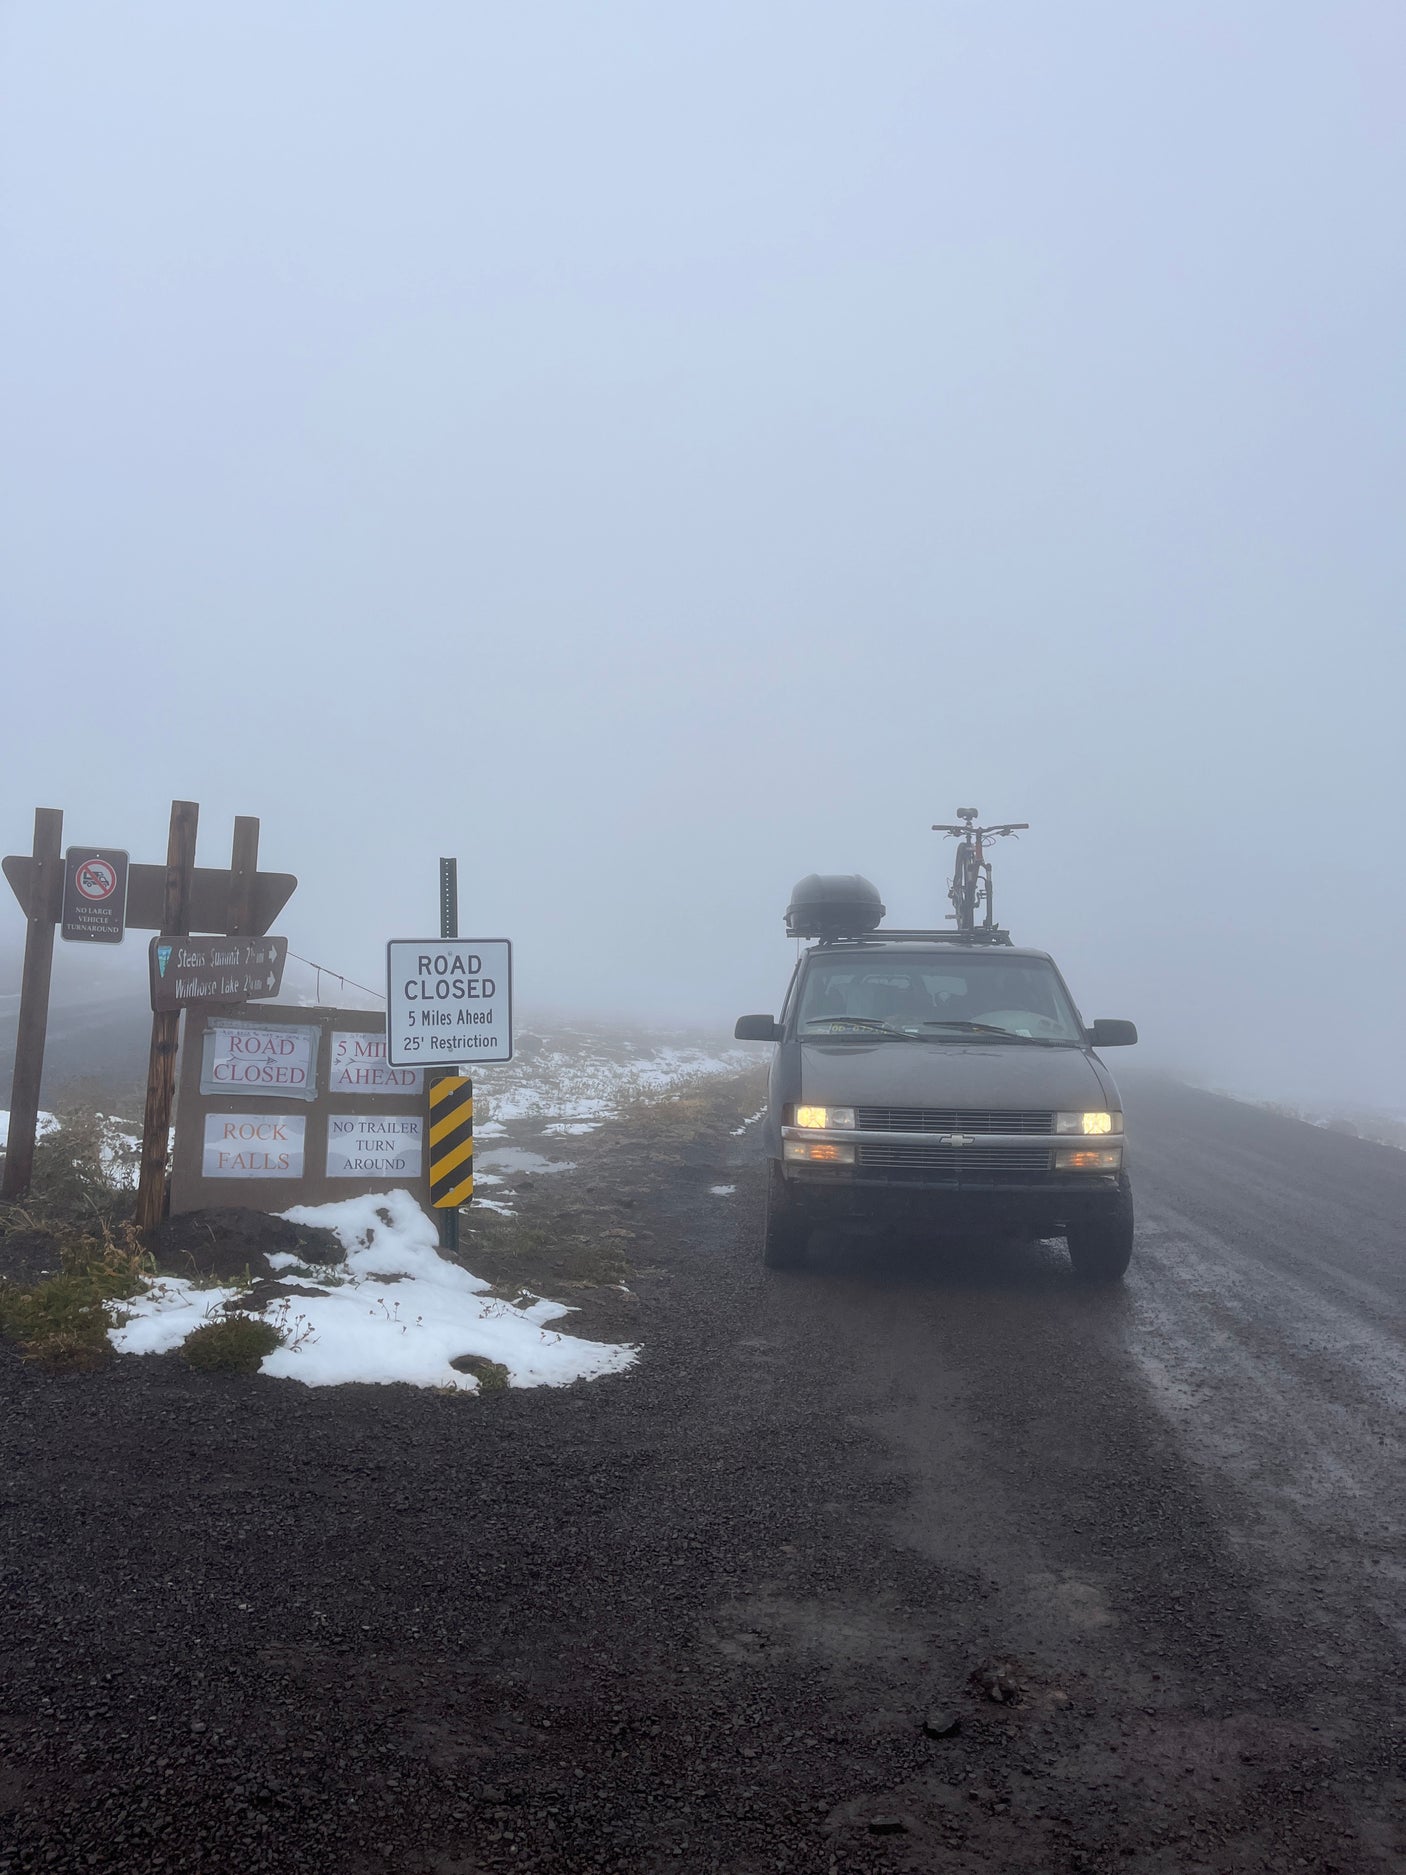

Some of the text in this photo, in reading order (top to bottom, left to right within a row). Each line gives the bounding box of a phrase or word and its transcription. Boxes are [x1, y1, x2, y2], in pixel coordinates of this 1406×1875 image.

[78, 915, 109, 924] VEHICLE
[88, 908, 113, 916] LARGE
[66, 923, 119, 933] TURNAROUND
[177, 948, 206, 968] Steens
[210, 946, 240, 968] Summit
[418, 954, 482, 976] ROAD
[175, 977, 217, 999] Wildhorse
[220, 975, 240, 994] Lake
[404, 978, 496, 1000] CLOSED
[408, 1008, 493, 1027] 5 Miles Ahead
[229, 1036, 295, 1056] ROAD
[336, 1040, 347, 1057] 5
[403, 1034, 498, 1051] 25' Restriction
[213, 1063, 305, 1084] CLOSED
[338, 1068, 416, 1086] AHEAD
[223, 1122, 288, 1141] ROCK
[333, 1121, 418, 1135] NO TRAILER
[356, 1140, 395, 1152] TURN
[218, 1151, 290, 1171] FALLS
[343, 1158, 406, 1171] AROUND
